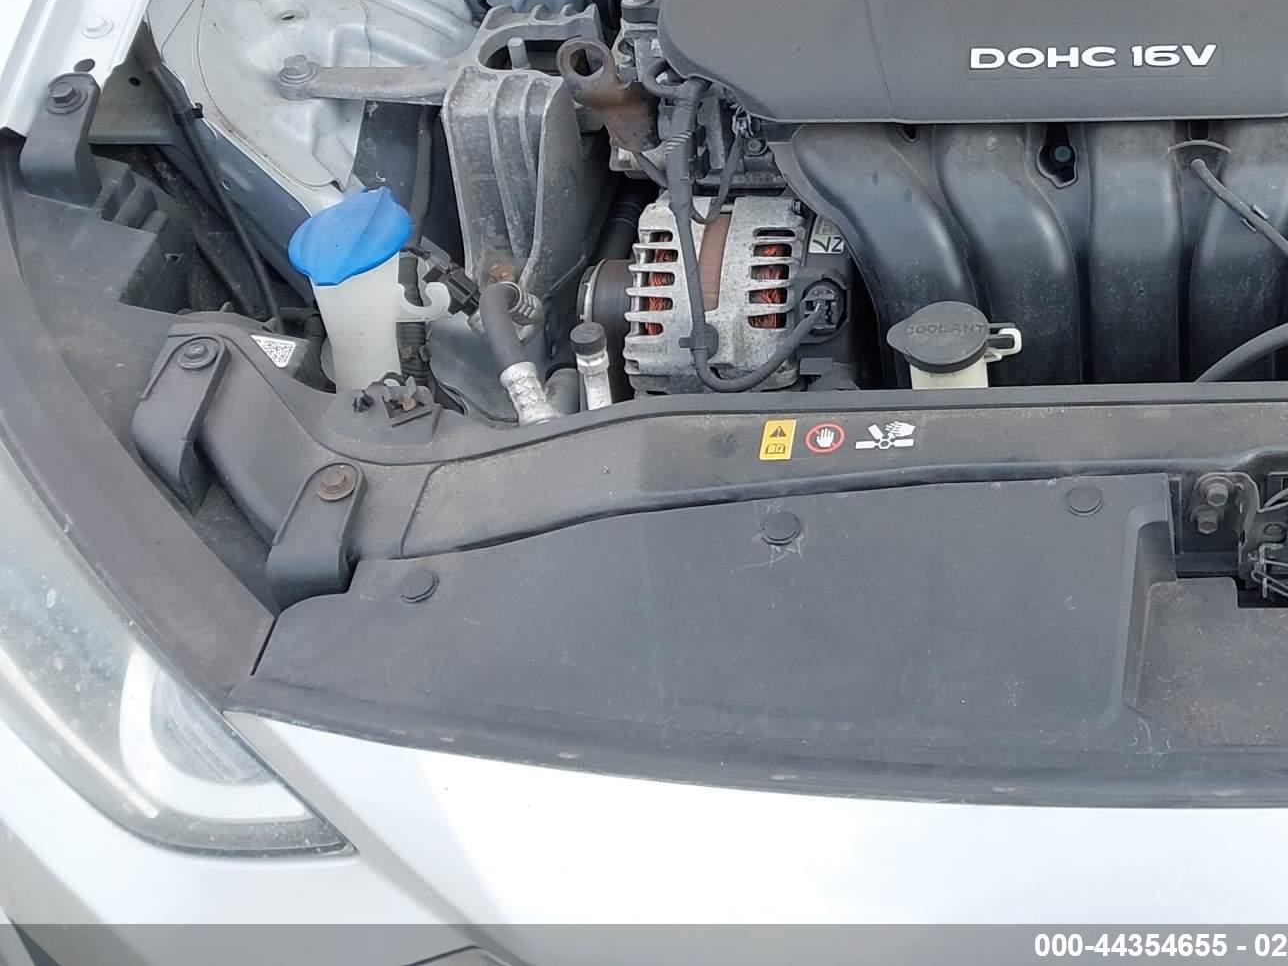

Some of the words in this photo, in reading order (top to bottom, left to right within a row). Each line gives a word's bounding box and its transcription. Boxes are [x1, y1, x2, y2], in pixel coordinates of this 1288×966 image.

[971, 47, 1115, 68] DOHC
[1132, 45, 1216, 66] 16V
[907, 323, 986, 335] COOLANT
